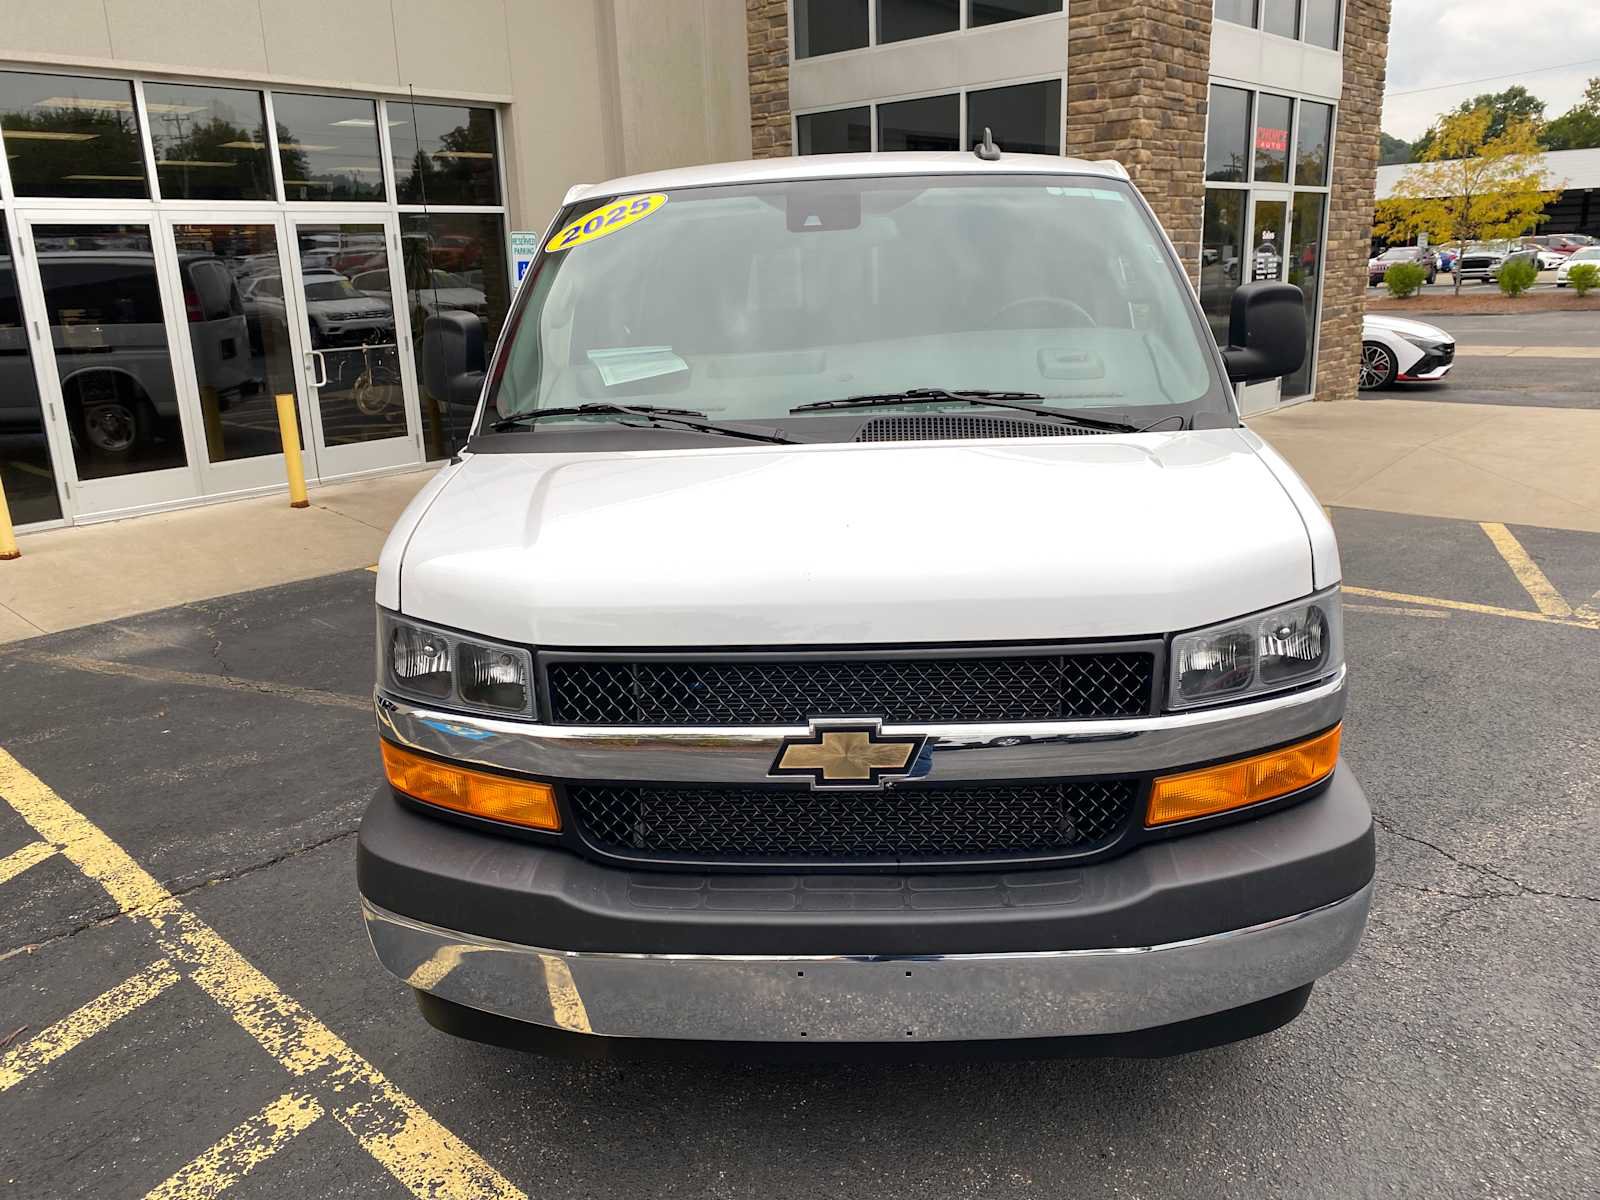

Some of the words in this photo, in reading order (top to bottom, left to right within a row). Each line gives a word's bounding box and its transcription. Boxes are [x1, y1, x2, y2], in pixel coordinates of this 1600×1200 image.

[1260, 142, 1281, 150] AUTO
[560, 197, 651, 246] 2025
[512, 237, 536, 246] RESERVED
[513, 247, 535, 256] PARKING
